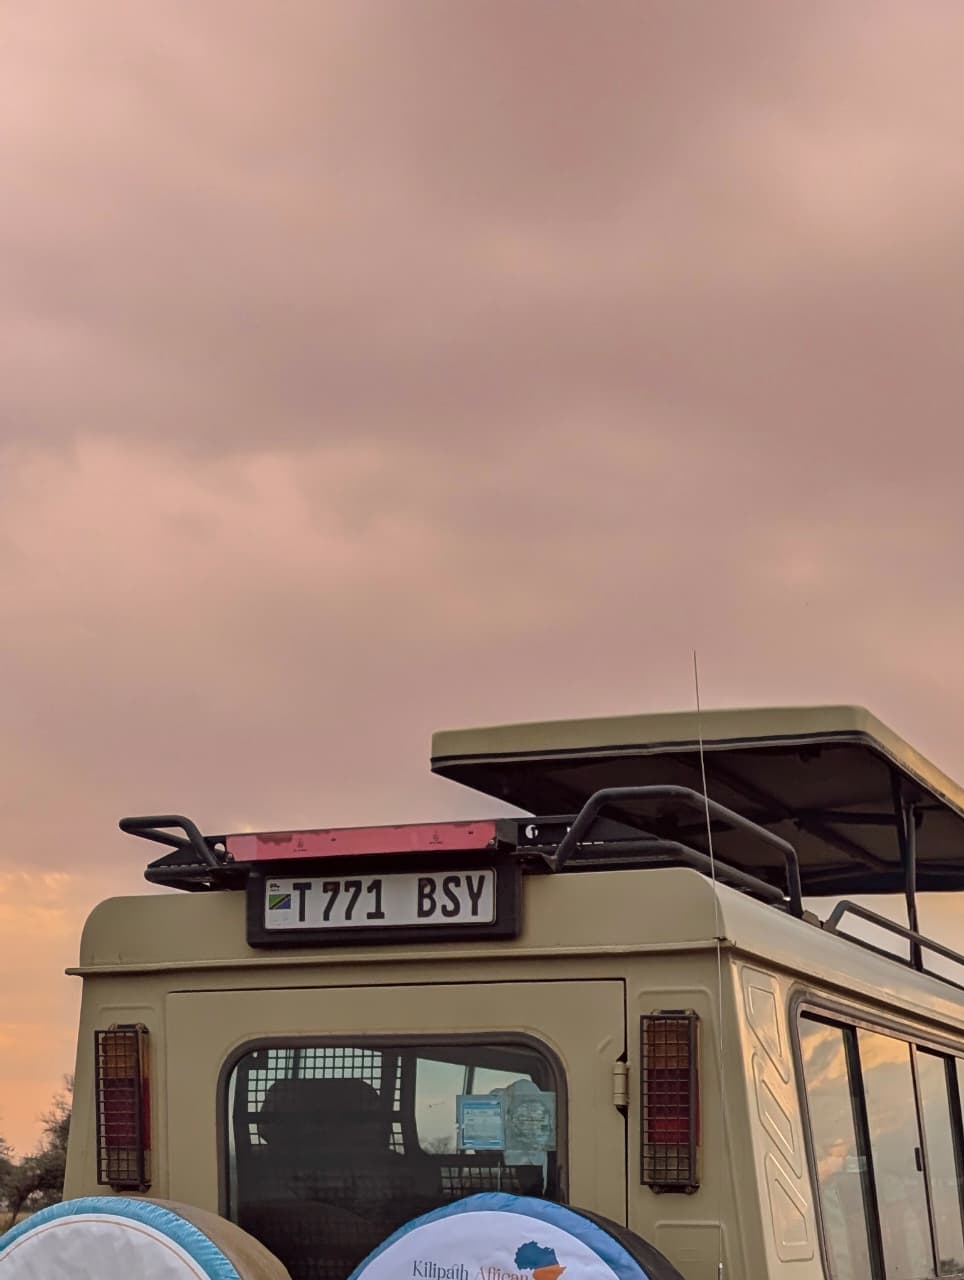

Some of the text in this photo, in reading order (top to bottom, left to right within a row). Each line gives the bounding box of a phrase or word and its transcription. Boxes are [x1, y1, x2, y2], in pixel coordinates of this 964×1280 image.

[293, 875, 486, 922] T 771 BSY
